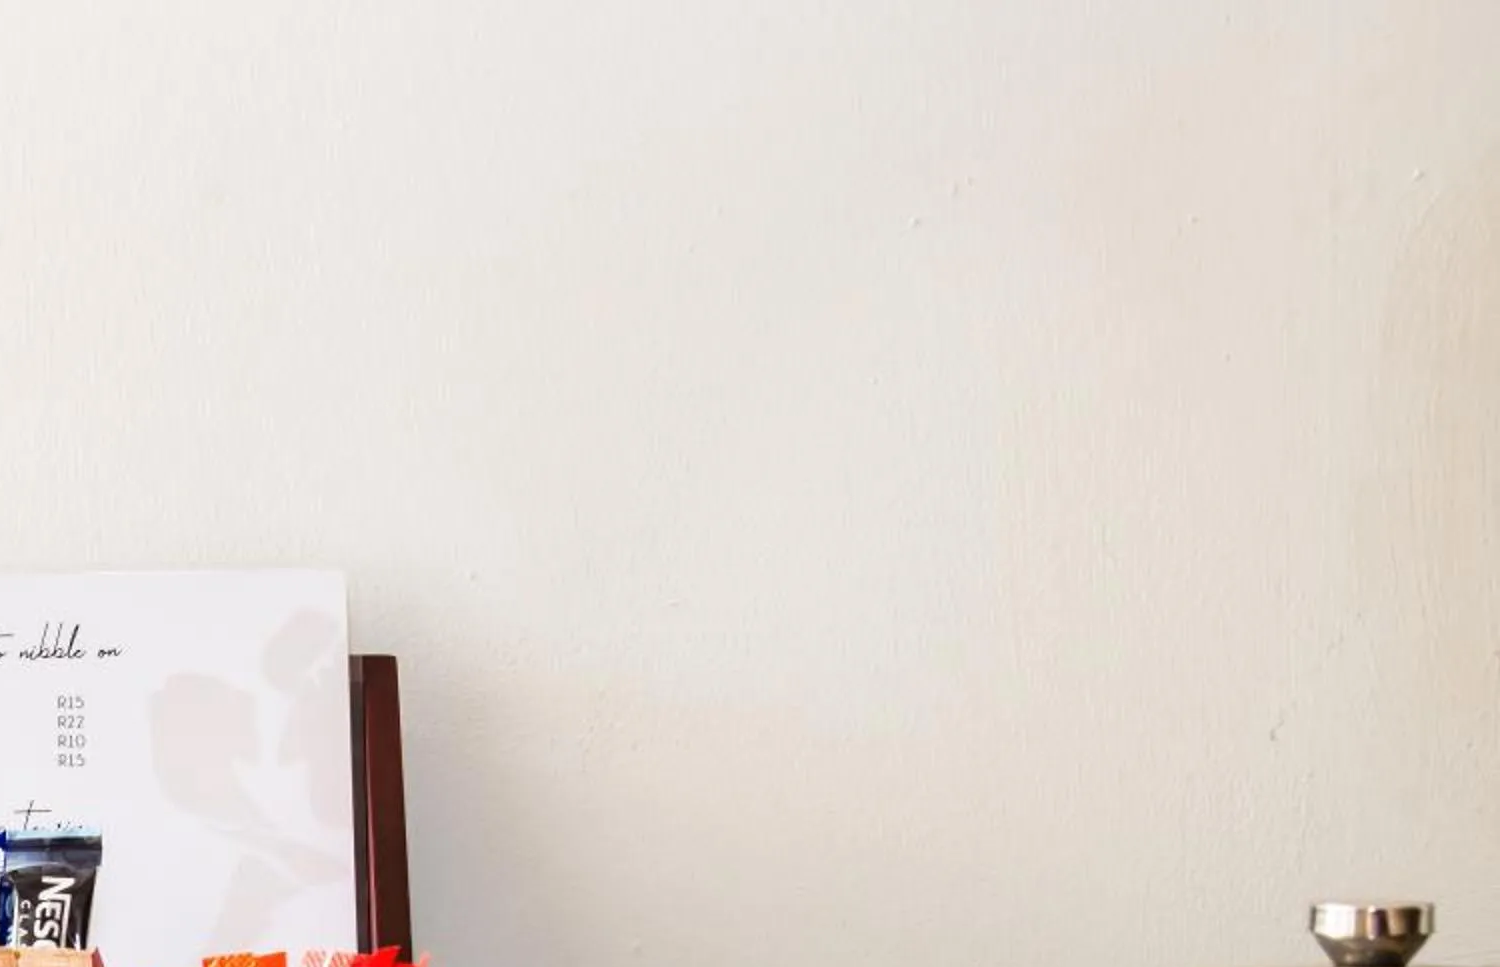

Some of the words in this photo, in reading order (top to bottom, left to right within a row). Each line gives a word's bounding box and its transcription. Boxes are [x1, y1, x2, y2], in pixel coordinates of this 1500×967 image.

[19, 622, 85, 660] nibble
[97, 645, 125, 658] on
[57, 696, 85, 709] R15
[57, 715, 85, 729] R22
[57, 735, 86, 748] R10
[57, 754, 85, 768] R15
